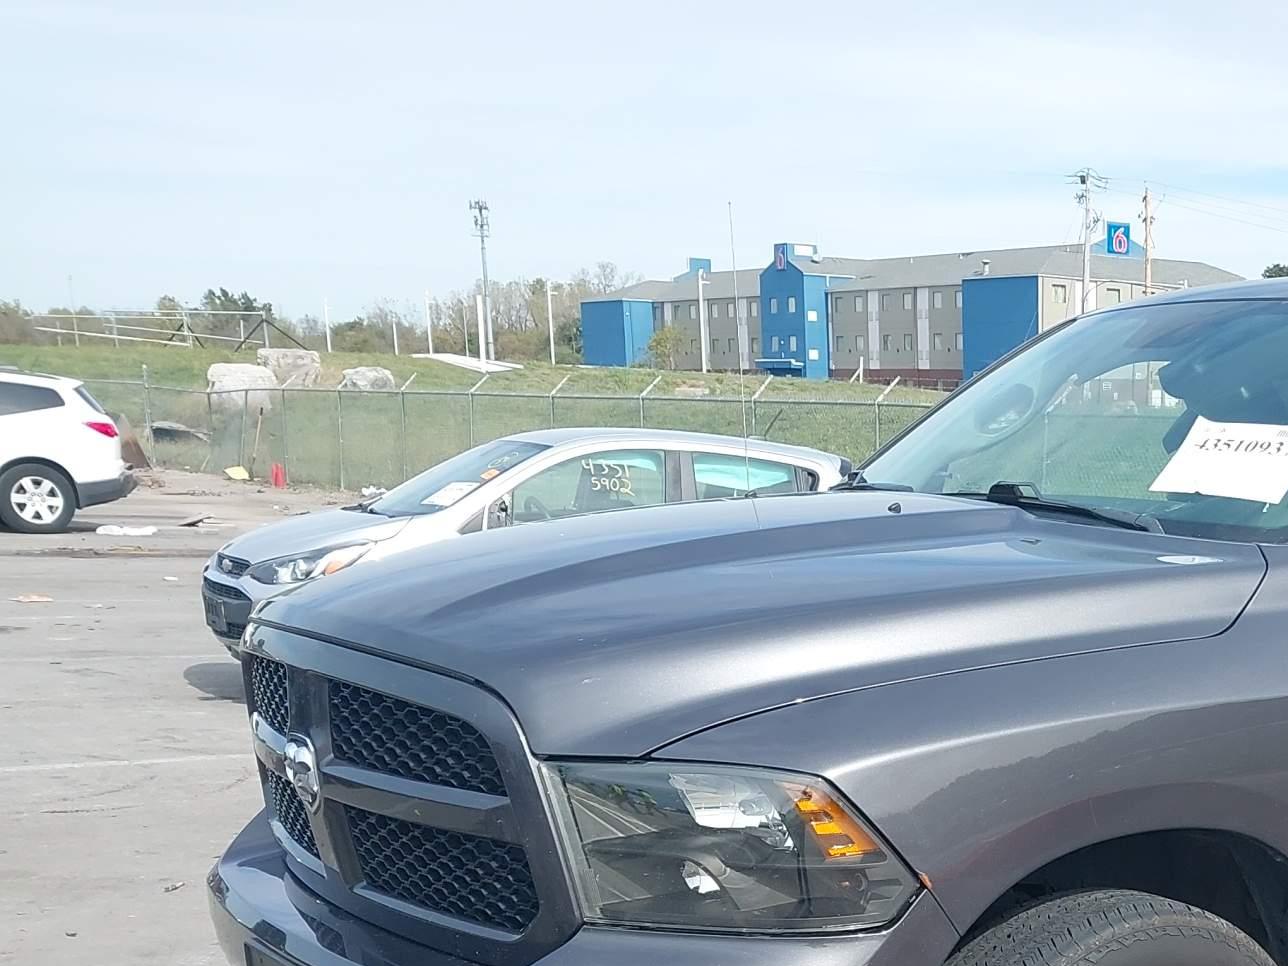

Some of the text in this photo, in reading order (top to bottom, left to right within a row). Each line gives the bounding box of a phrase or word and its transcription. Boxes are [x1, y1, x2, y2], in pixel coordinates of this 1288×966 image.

[1113, 227, 1128, 253] 6
[581, 459, 630, 478] 4351
[591, 477, 636, 497] 5902
